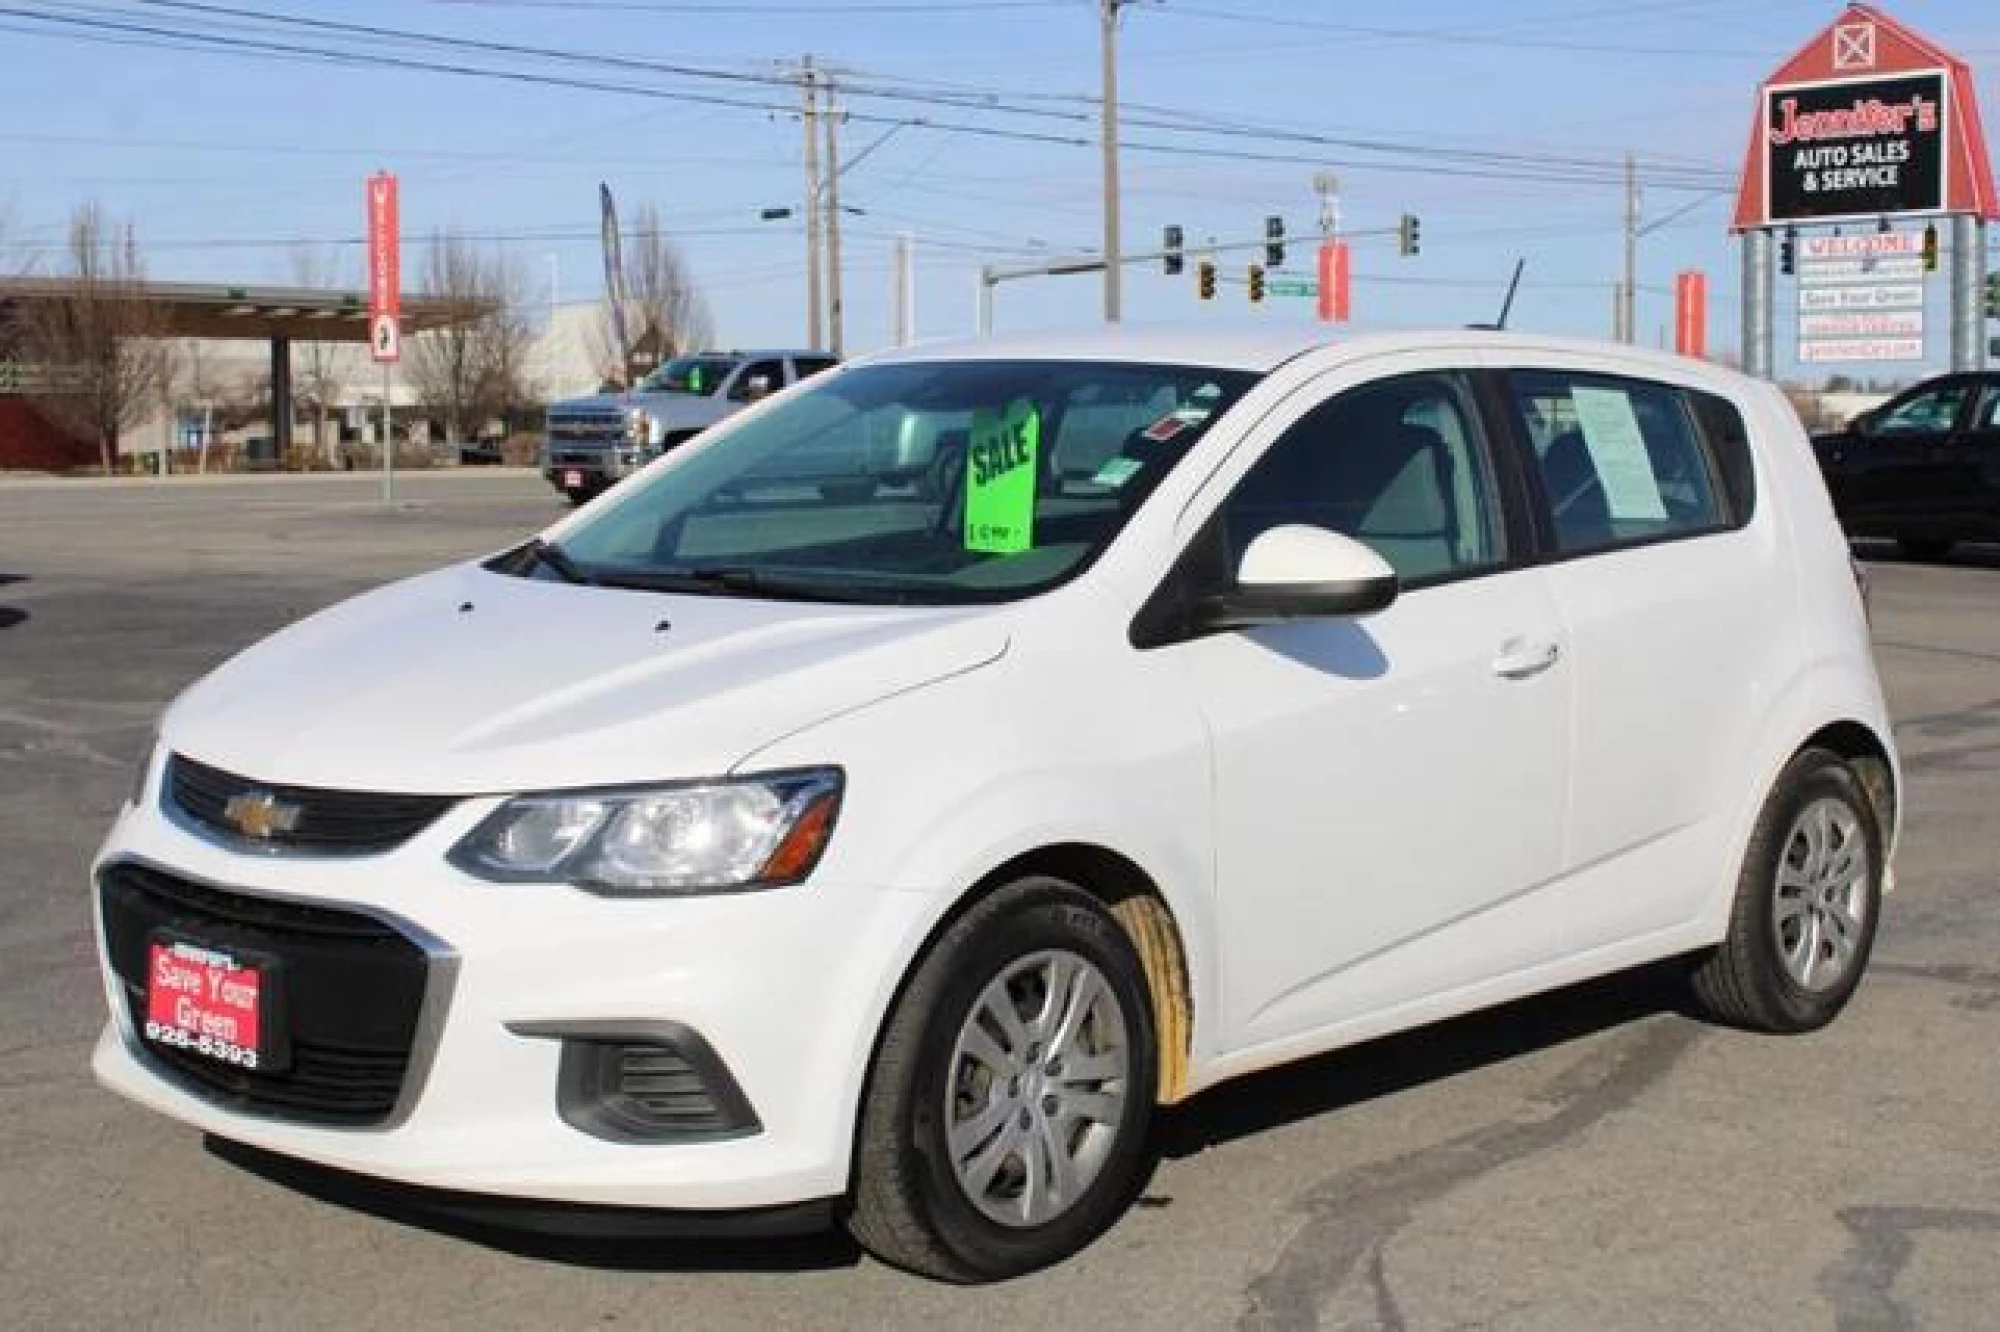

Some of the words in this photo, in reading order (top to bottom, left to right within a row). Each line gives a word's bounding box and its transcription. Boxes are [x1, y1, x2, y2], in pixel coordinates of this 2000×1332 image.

[1770, 94, 1938, 145] Jennifer's
[1794, 146, 1848, 170] AUTO
[1852, 140, 1910, 165] SALES
[1803, 170, 1818, 192] &
[1821, 165, 1898, 191] SERVICE
[1808, 235, 1908, 254] WELCOME
[973, 420, 1031, 488] SALE
[156, 953, 201, 994] Save
[206, 966, 258, 1011] Your
[177, 996, 238, 1041] Green
